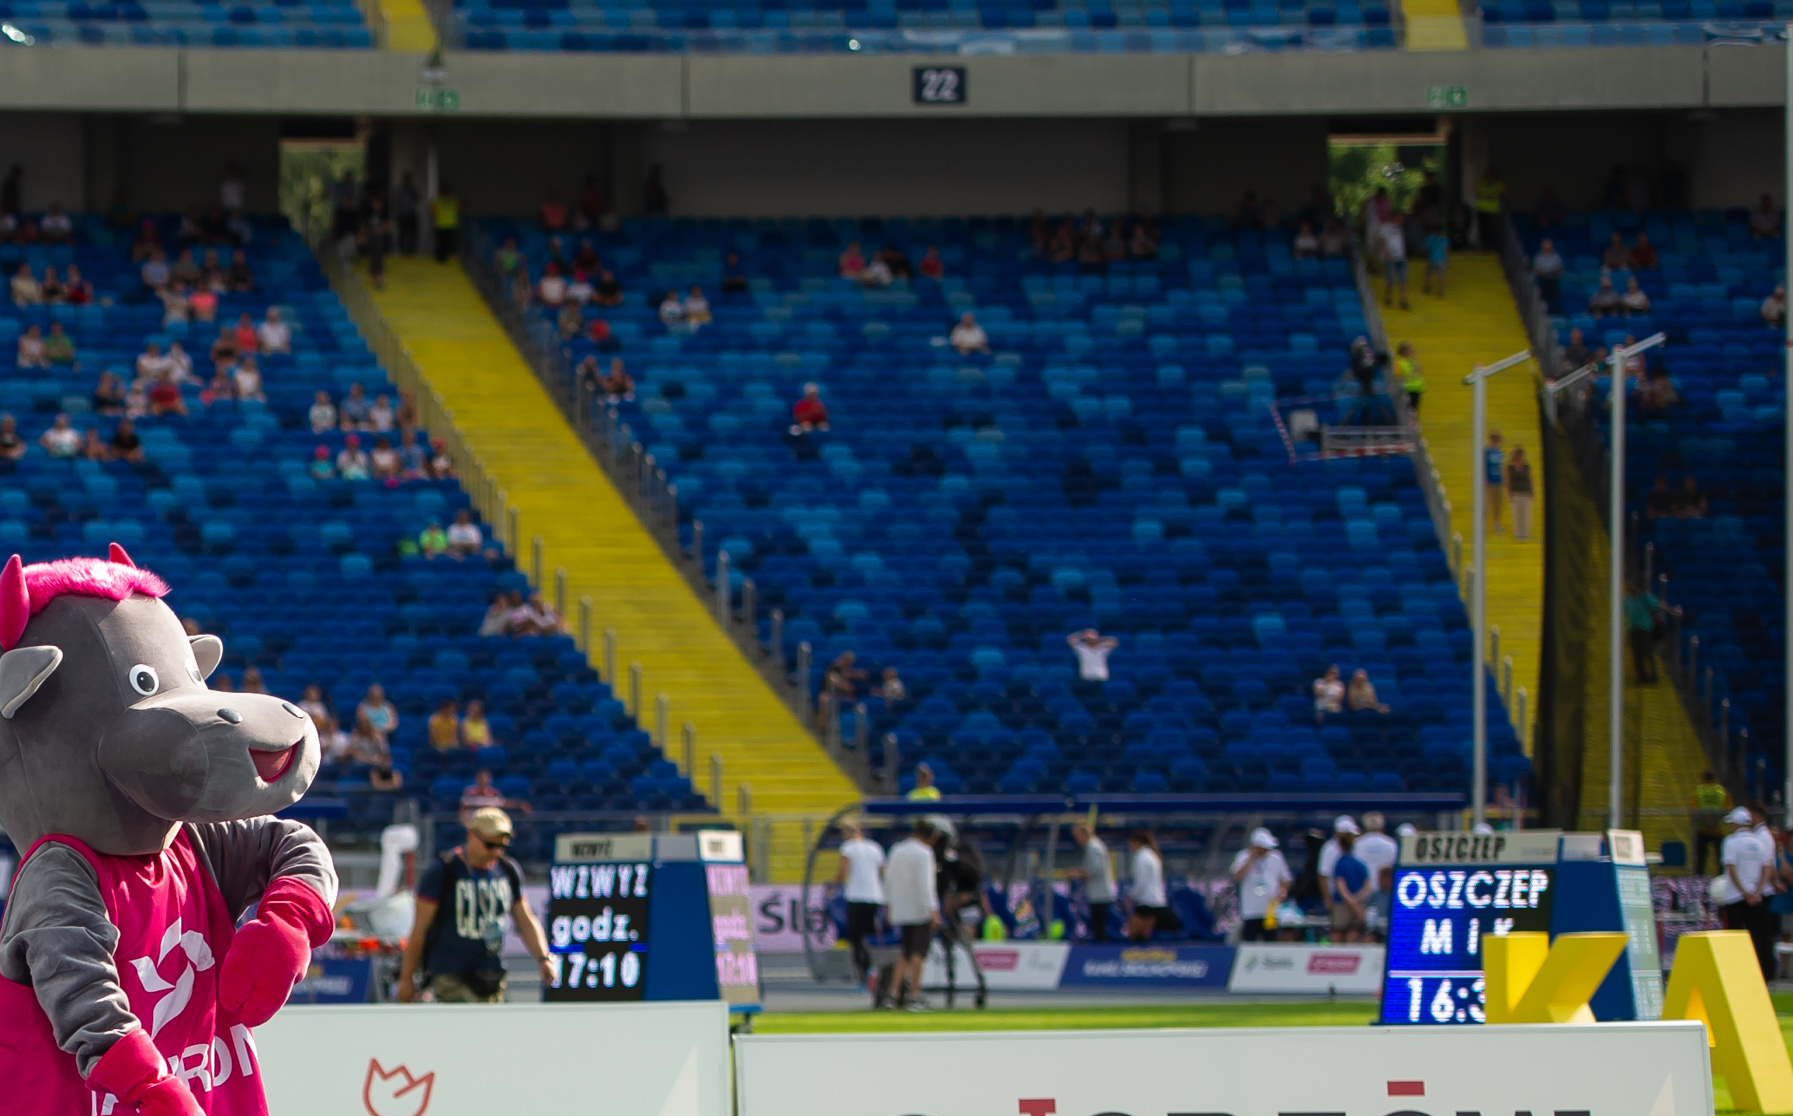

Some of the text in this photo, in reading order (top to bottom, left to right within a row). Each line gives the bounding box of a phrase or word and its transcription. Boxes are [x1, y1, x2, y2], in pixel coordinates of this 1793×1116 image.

[922, 70, 959, 100] 22
[1415, 835, 1506, 862] OSZCZEP
[1397, 869, 1549, 909] OSZCZEP
[551, 905, 639, 949] godz.
[1420, 918, 1452, 955] M
[550, 951, 641, 989] 17:10
